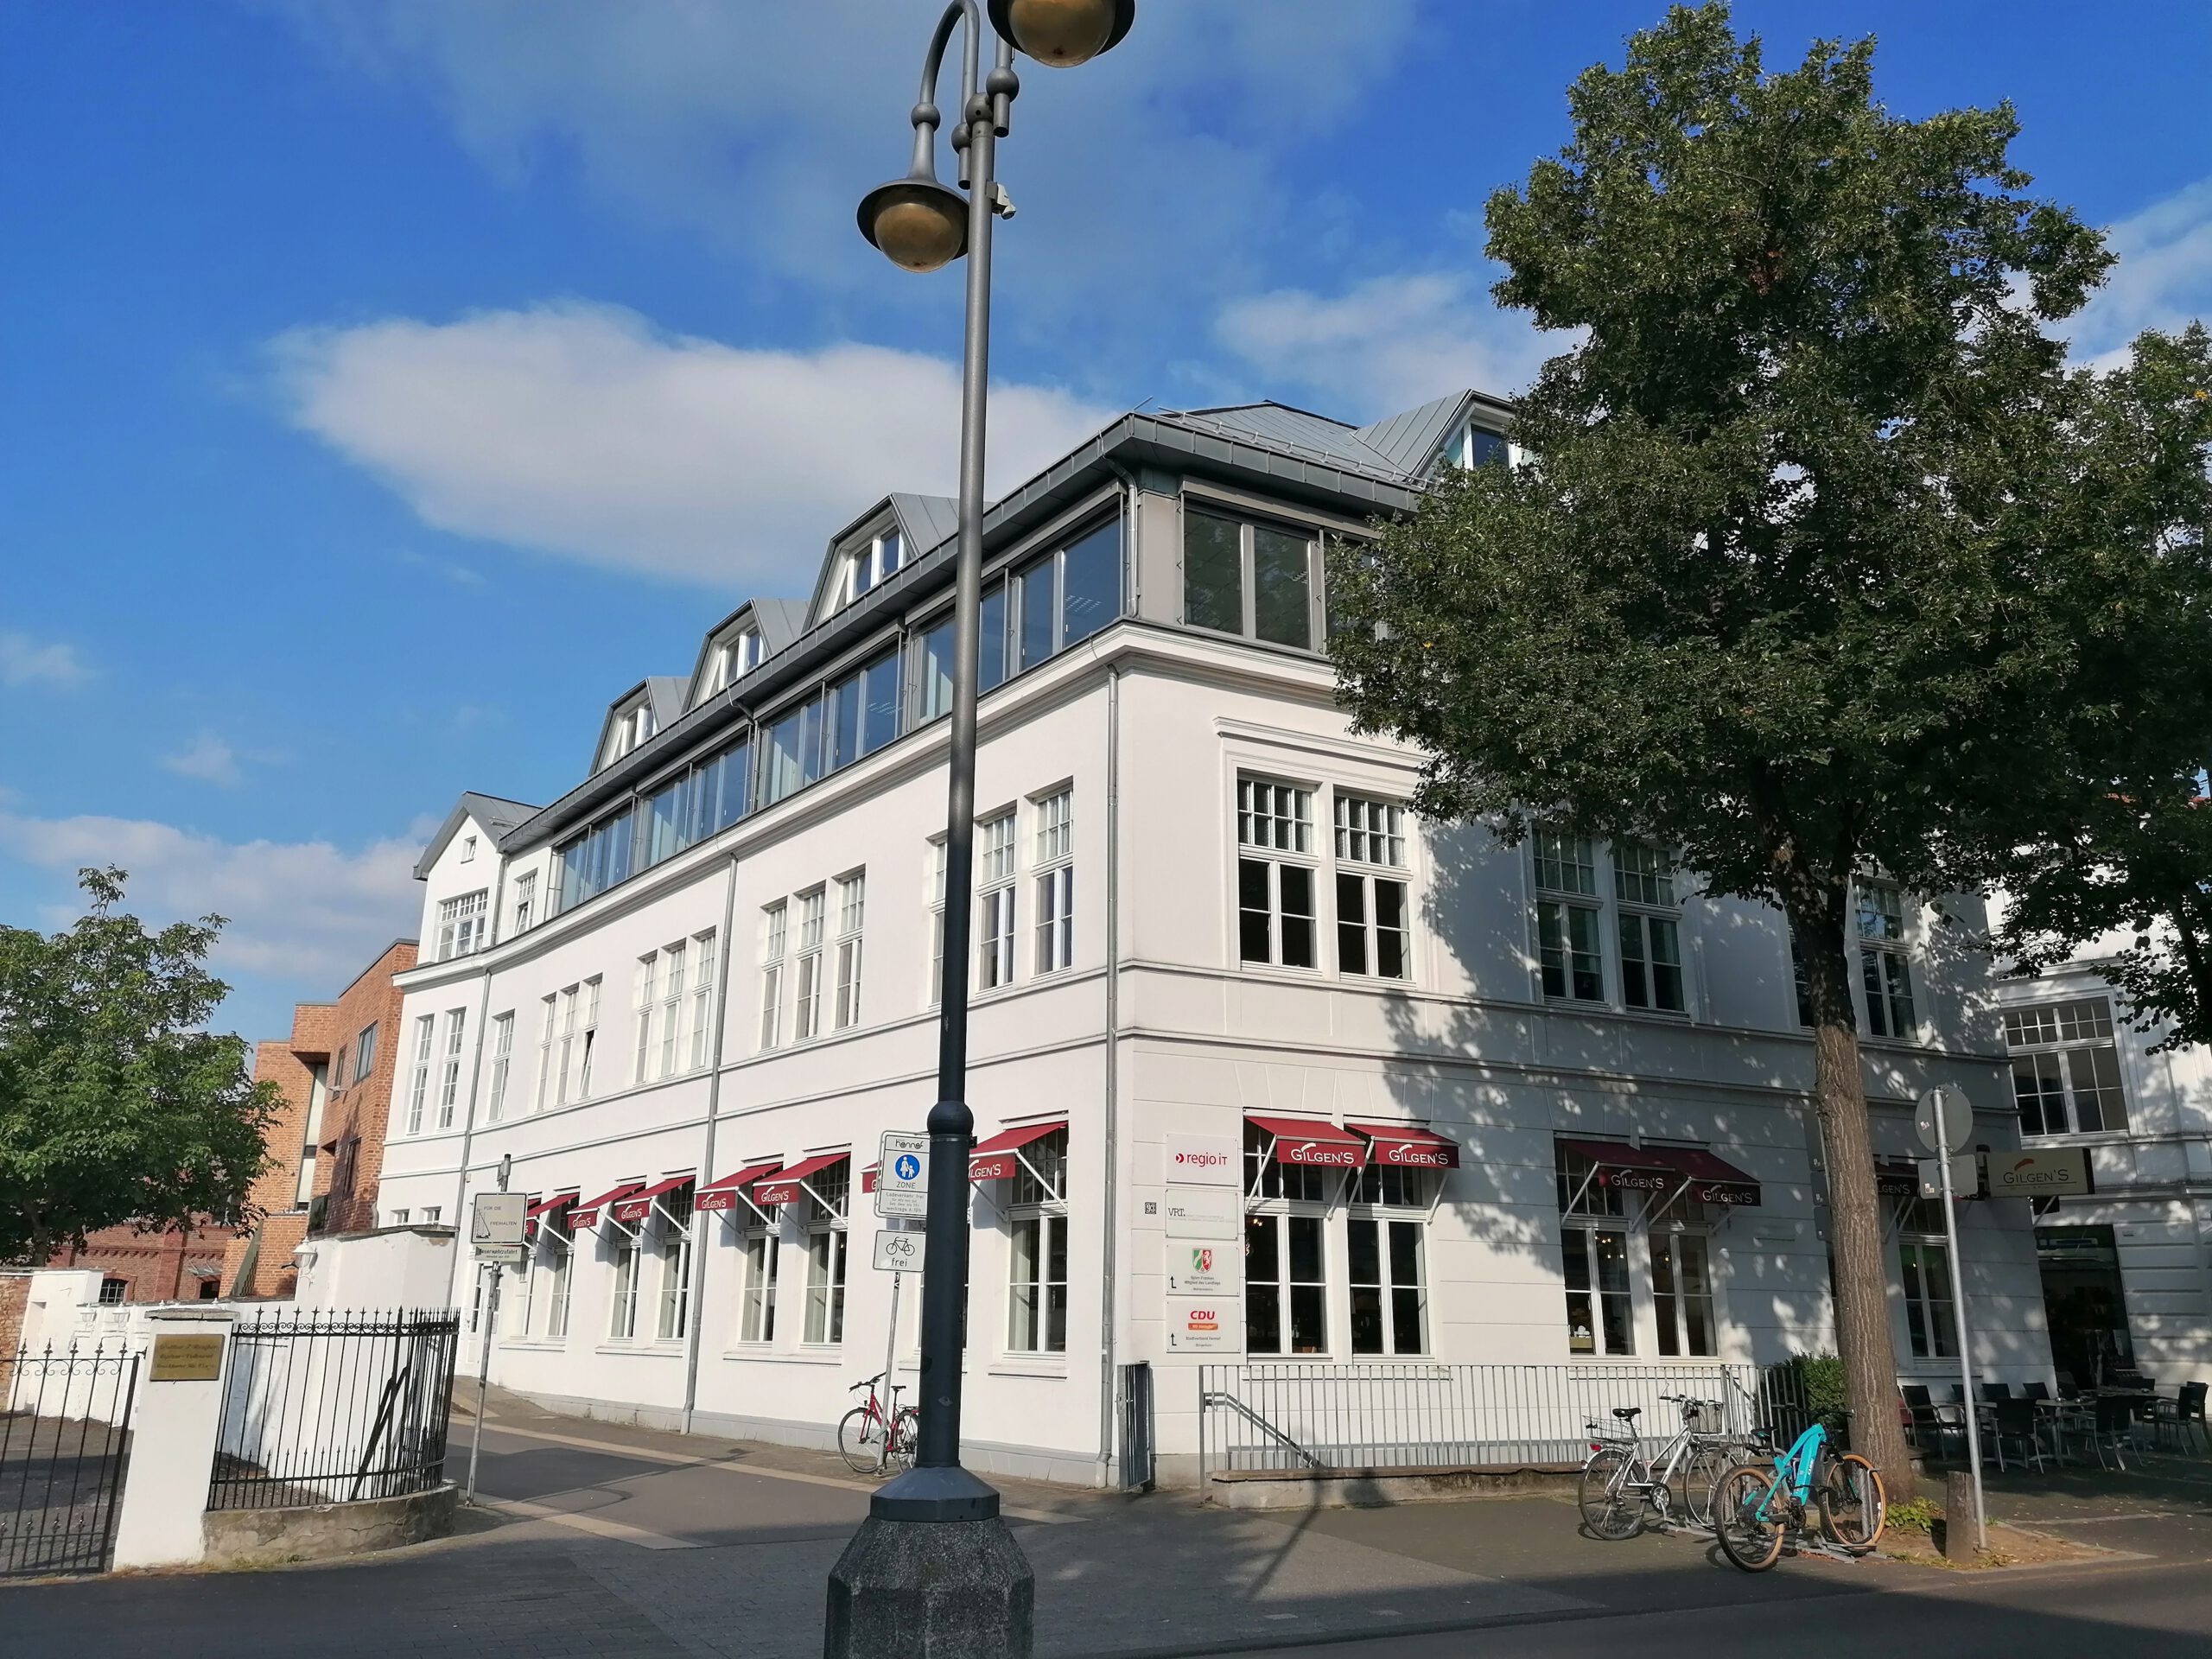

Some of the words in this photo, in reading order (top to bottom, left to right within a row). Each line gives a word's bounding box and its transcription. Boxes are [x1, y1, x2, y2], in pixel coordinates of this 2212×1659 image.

[1186, 1152, 1217, 1167] regio
[1290, 1148, 1355, 1165] GILGEN'S
[1389, 1149, 1449, 1166] GILGEN'S
[969, 1163, 1001, 1179] ILGEN'S
[2003, 1169, 2069, 1184] GILGEN'S
[1611, 1174, 1664, 1189] GILGEN'S
[702, 1198, 727, 1209] GILGEN'S
[761, 1191, 789, 1202] GILGEN'S
[1702, 1190, 1753, 1204] GILGEN'S
[892, 1257, 907, 1267] frei
[1190, 1310, 1216, 1320] CDU
